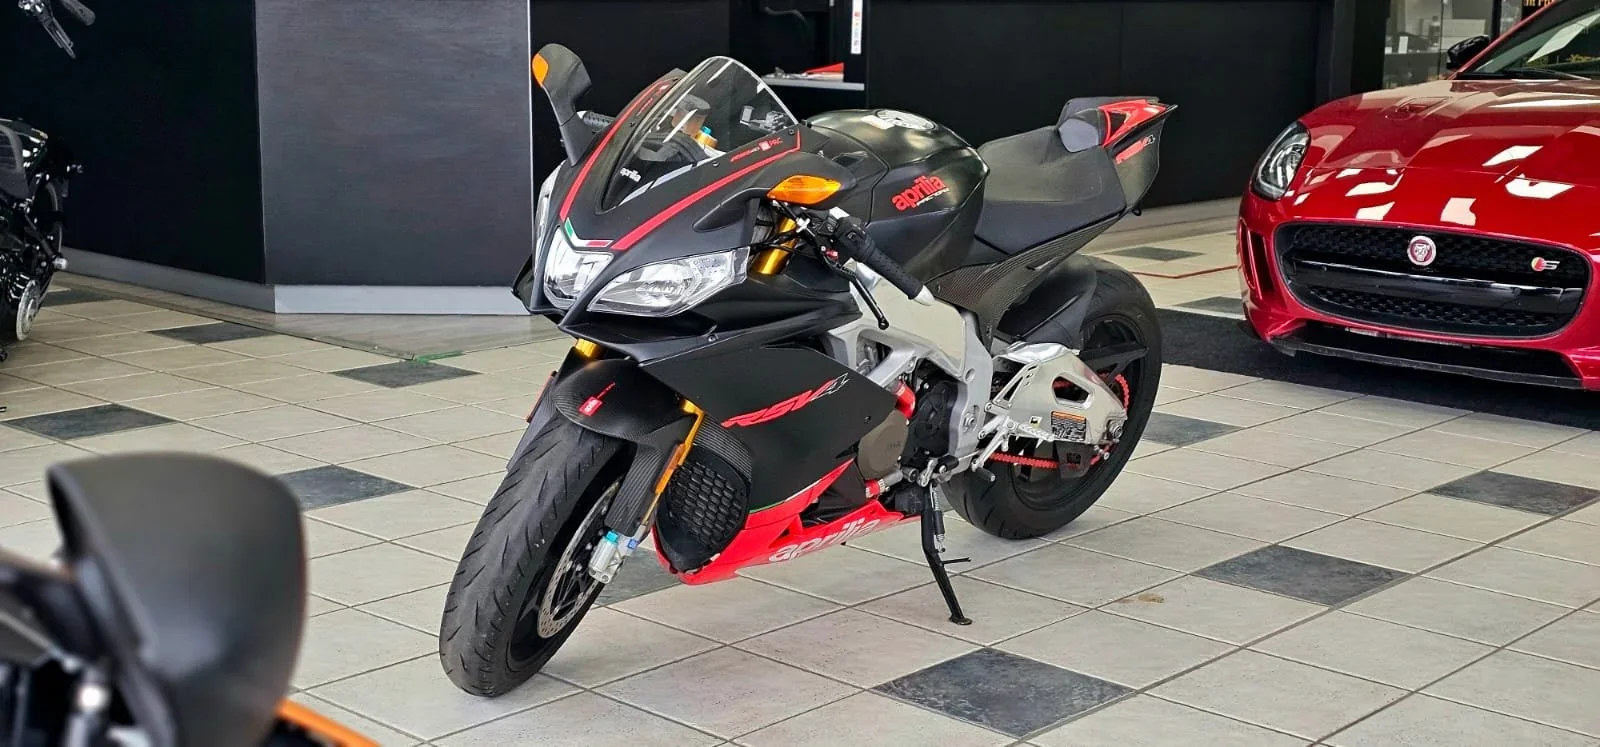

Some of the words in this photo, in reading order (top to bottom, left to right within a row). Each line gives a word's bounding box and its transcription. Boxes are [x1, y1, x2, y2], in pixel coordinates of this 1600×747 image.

[620, 167, 642, 182] aprilia
[892, 175, 946, 210] aprilia
[768, 517, 881, 562] aprilia
